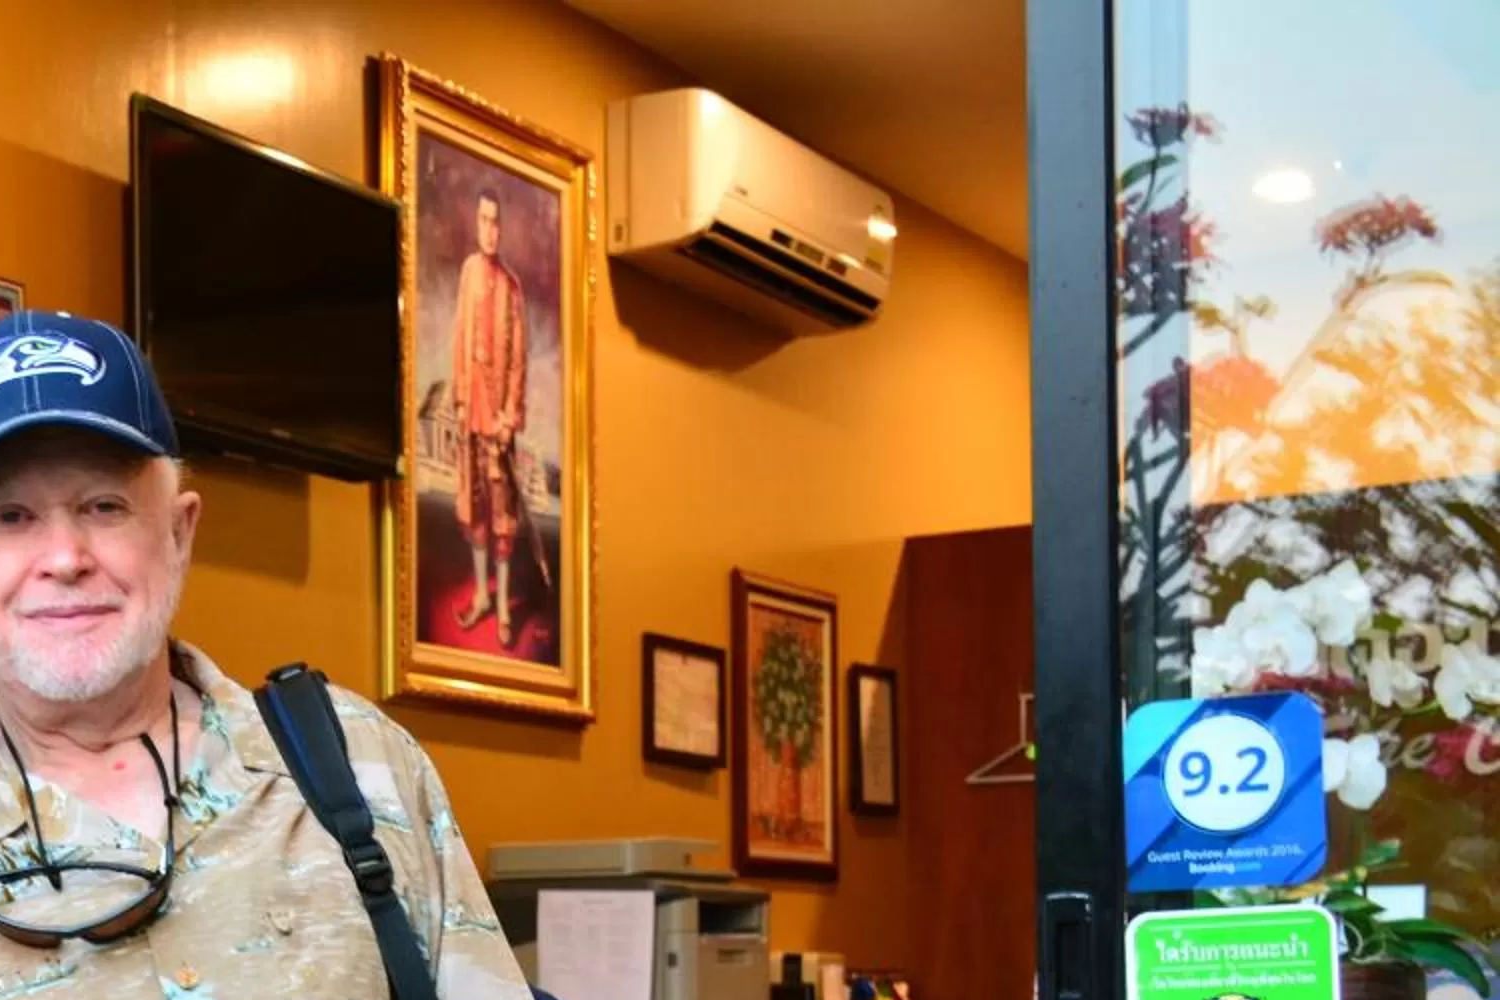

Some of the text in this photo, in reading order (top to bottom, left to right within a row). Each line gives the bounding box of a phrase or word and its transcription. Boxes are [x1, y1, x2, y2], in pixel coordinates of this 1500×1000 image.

[1179, 746, 1270, 797] 9.2
[1147, 850, 1182, 863] Guest
[1183, 848, 1224, 861] Review
